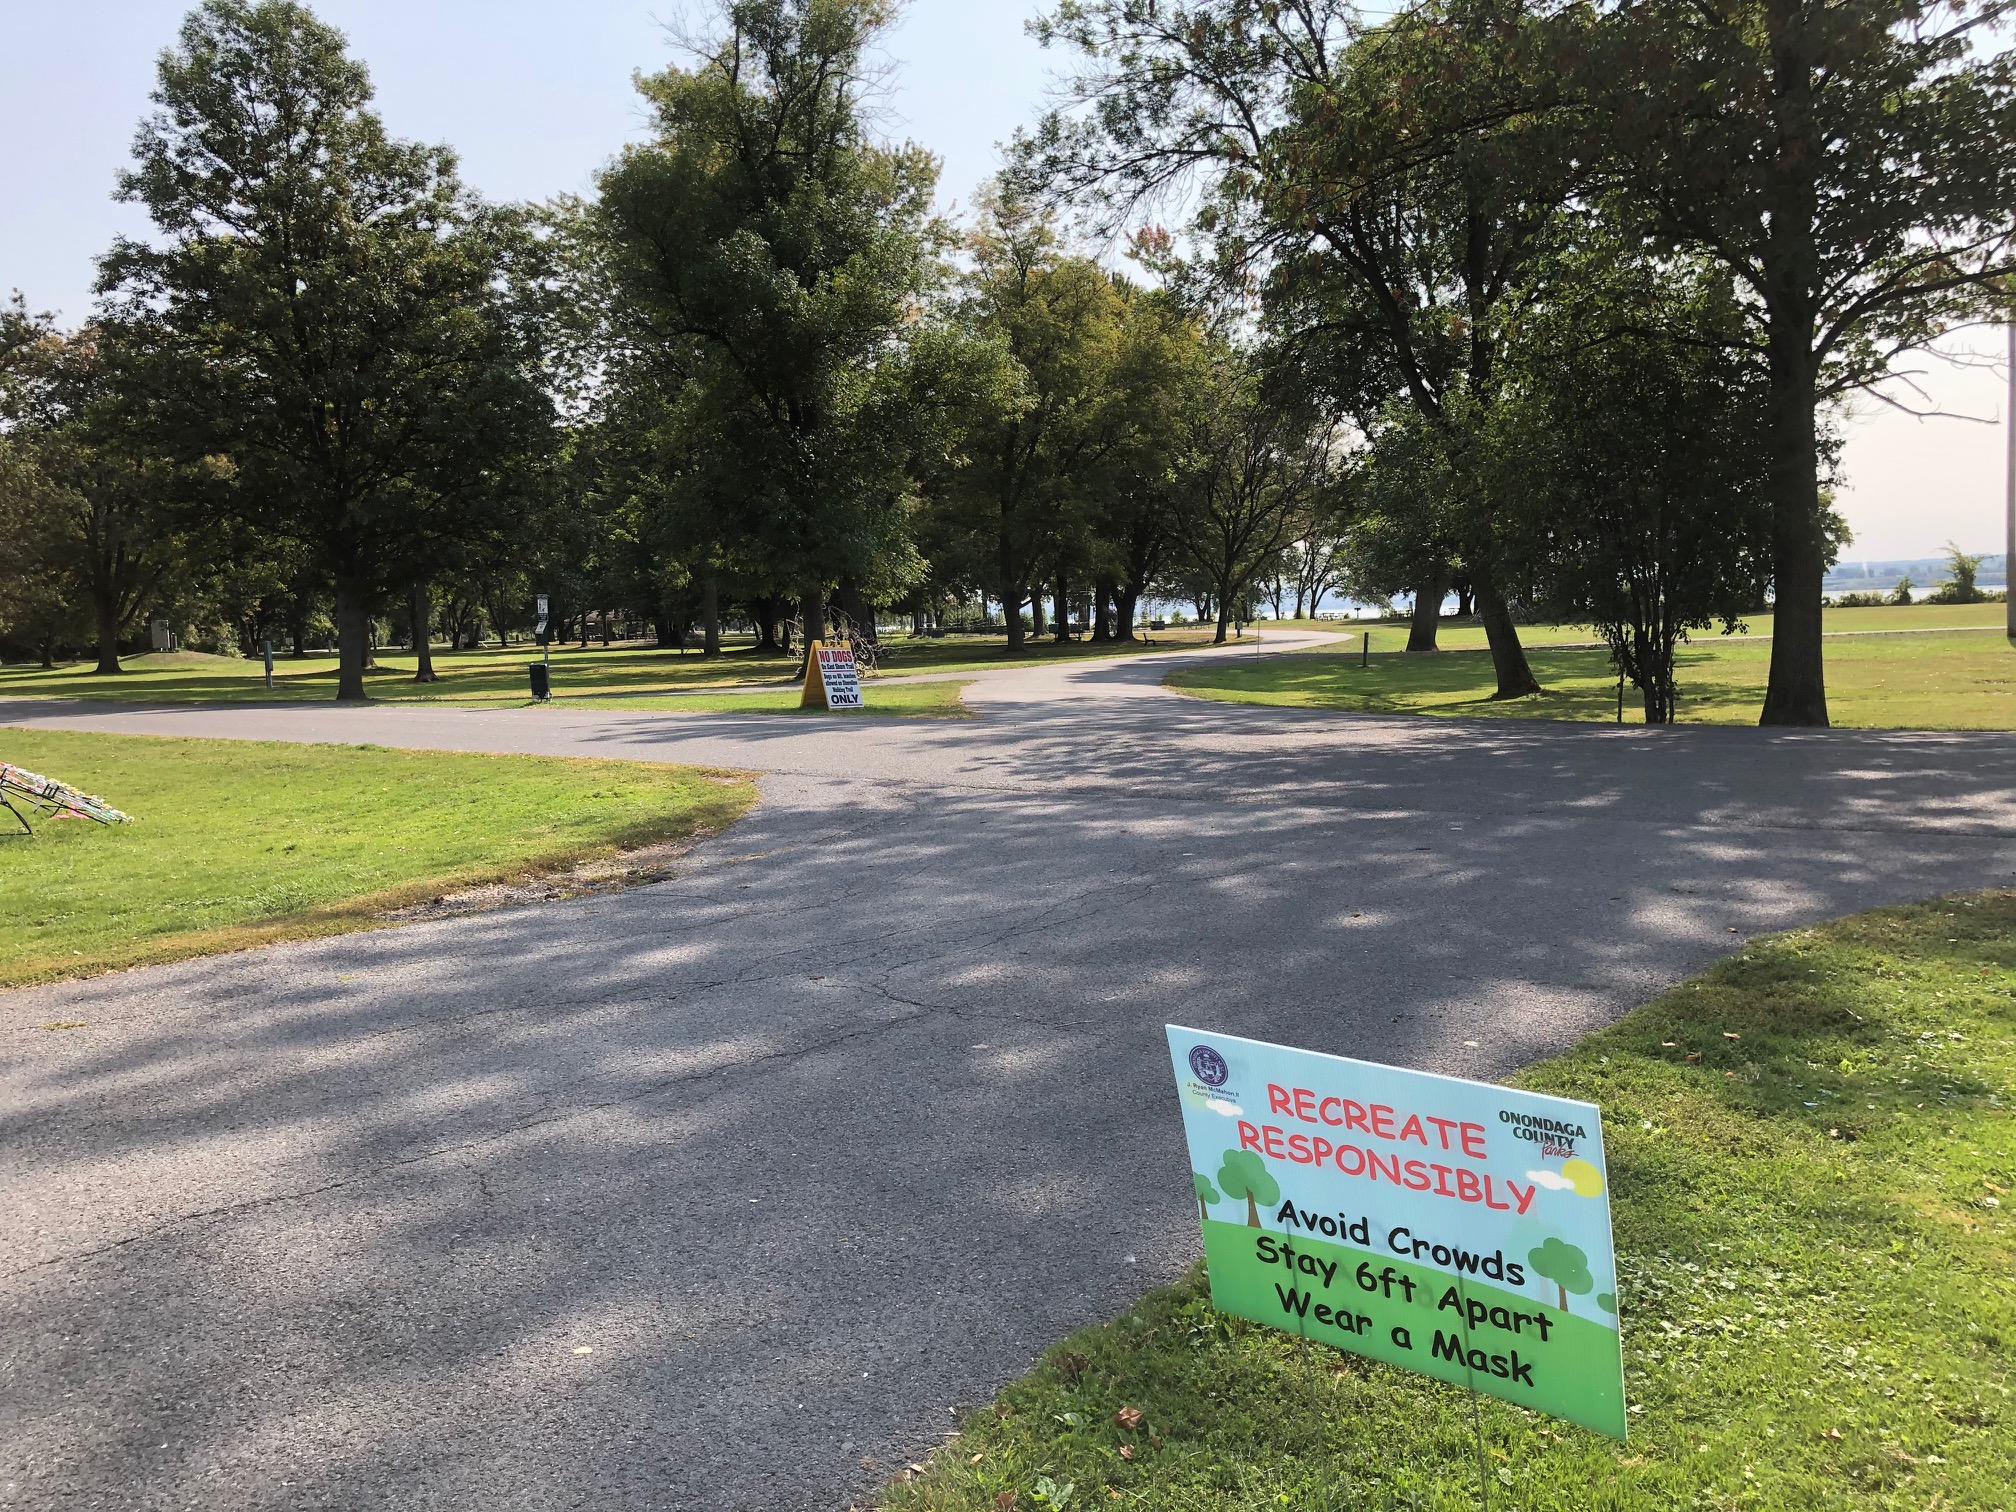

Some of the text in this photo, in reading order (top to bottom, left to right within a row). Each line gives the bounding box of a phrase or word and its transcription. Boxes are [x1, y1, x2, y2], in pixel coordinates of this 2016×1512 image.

[818, 651, 853, 662] NO DOGS
[831, 694, 858, 704] ONLY
[1192, 1090, 1236, 1103] County Executive
[1267, 1083, 1488, 1160] RECREATE
[1498, 1110, 1586, 1138] ONONDAGA
[1513, 1126, 1574, 1149] COUNTY
[1534, 1140, 1579, 1161] Parks
[1238, 1120, 1536, 1215] RESPONSIBLY
[1277, 1200, 1525, 1286] Avoid Crowds
[1256, 1236, 1554, 1342] Stay 6ft Apart
[1274, 1282, 1534, 1387] Wear a Mask
